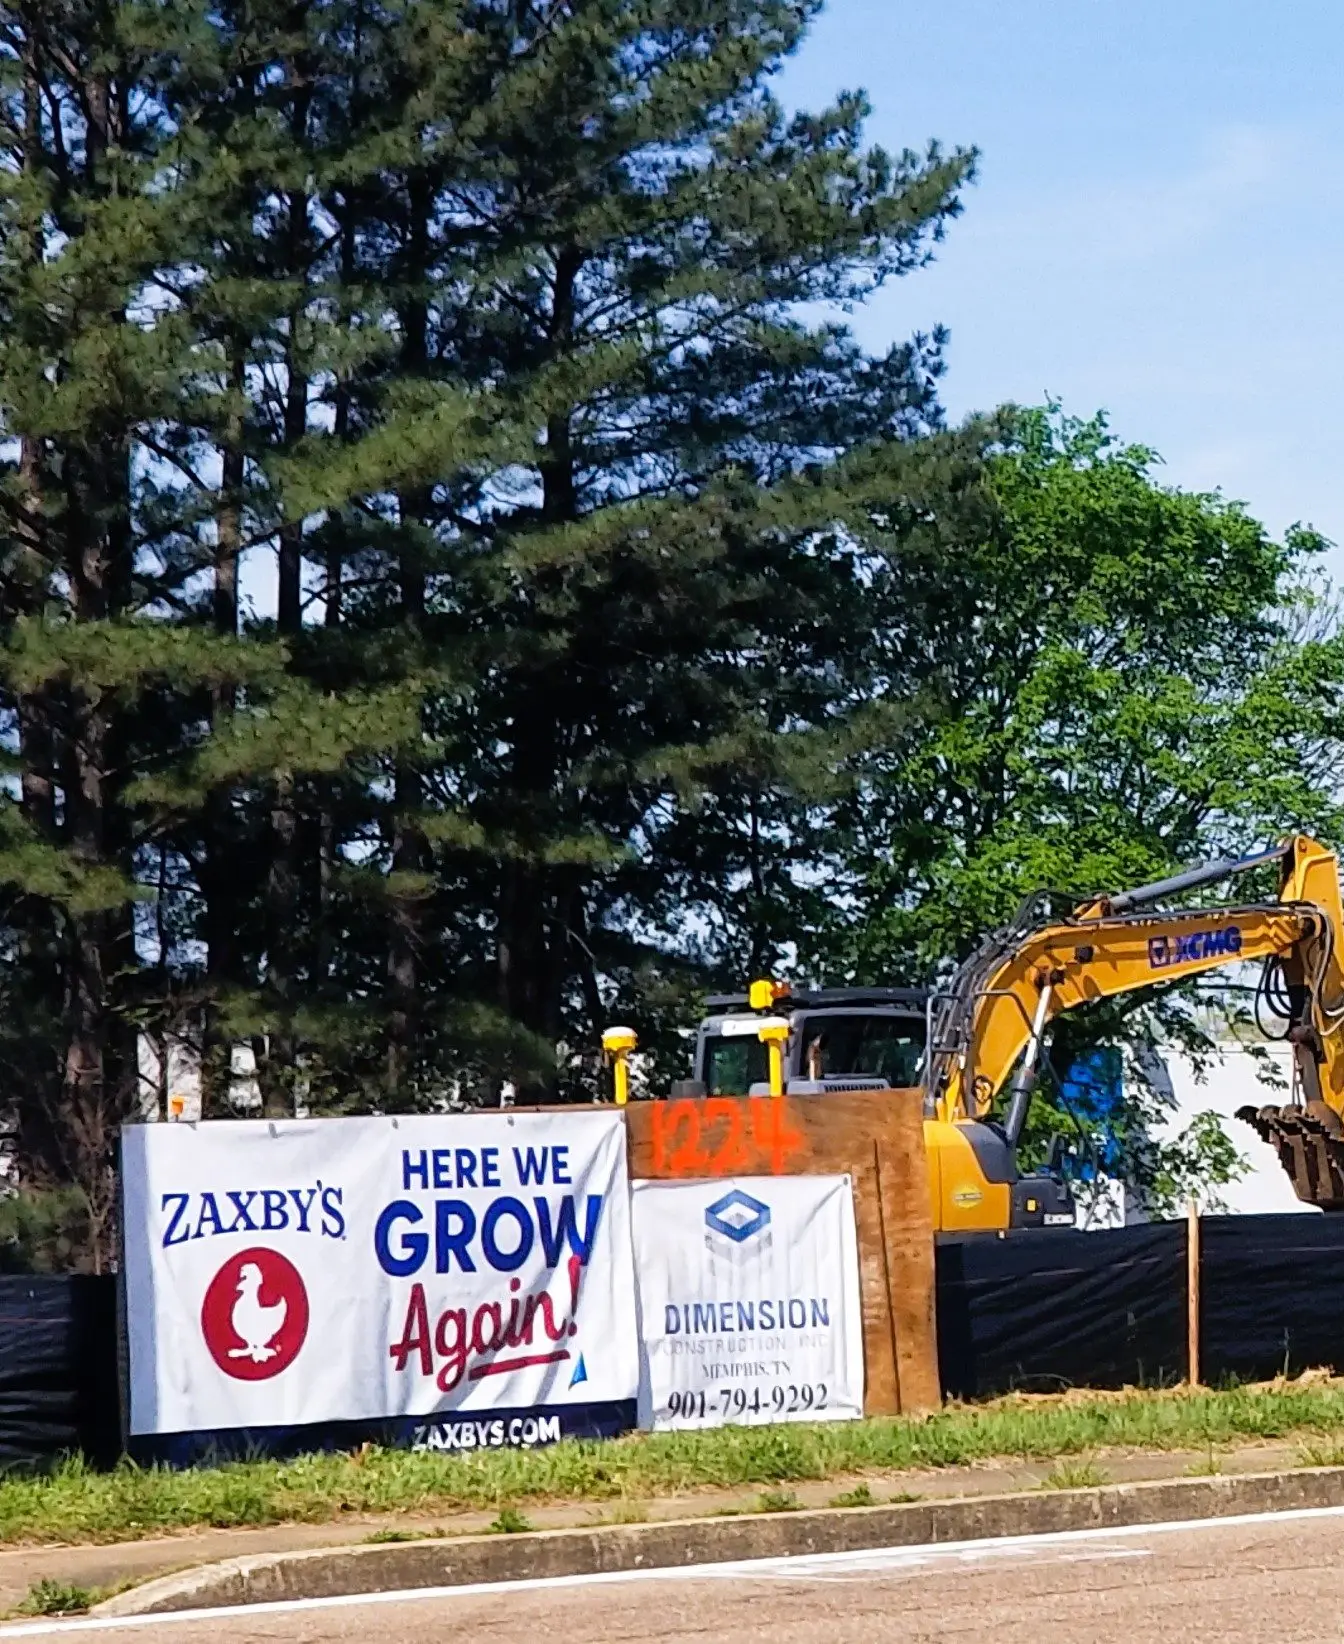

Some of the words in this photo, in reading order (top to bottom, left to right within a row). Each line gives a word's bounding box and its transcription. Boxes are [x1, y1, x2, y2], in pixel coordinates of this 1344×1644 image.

[1174, 926, 1242, 963] XCMG
[653, 1096, 803, 1178] 1224
[402, 1148, 500, 1190] HERE
[512, 1145, 572, 1185] WE
[161, 1180, 346, 1248] ZAXBY'S
[374, 1194, 603, 1278] GROW
[390, 1254, 582, 1393] Again!
[665, 1298, 830, 1335] DIMENSION
[662, 1336, 787, 1356] CONSTRUCTION
[774, 1360, 792, 1376] TN
[667, 1383, 829, 1420] 901-794-9292
[413, 1415, 562, 1452] ZAXBYS.COM
